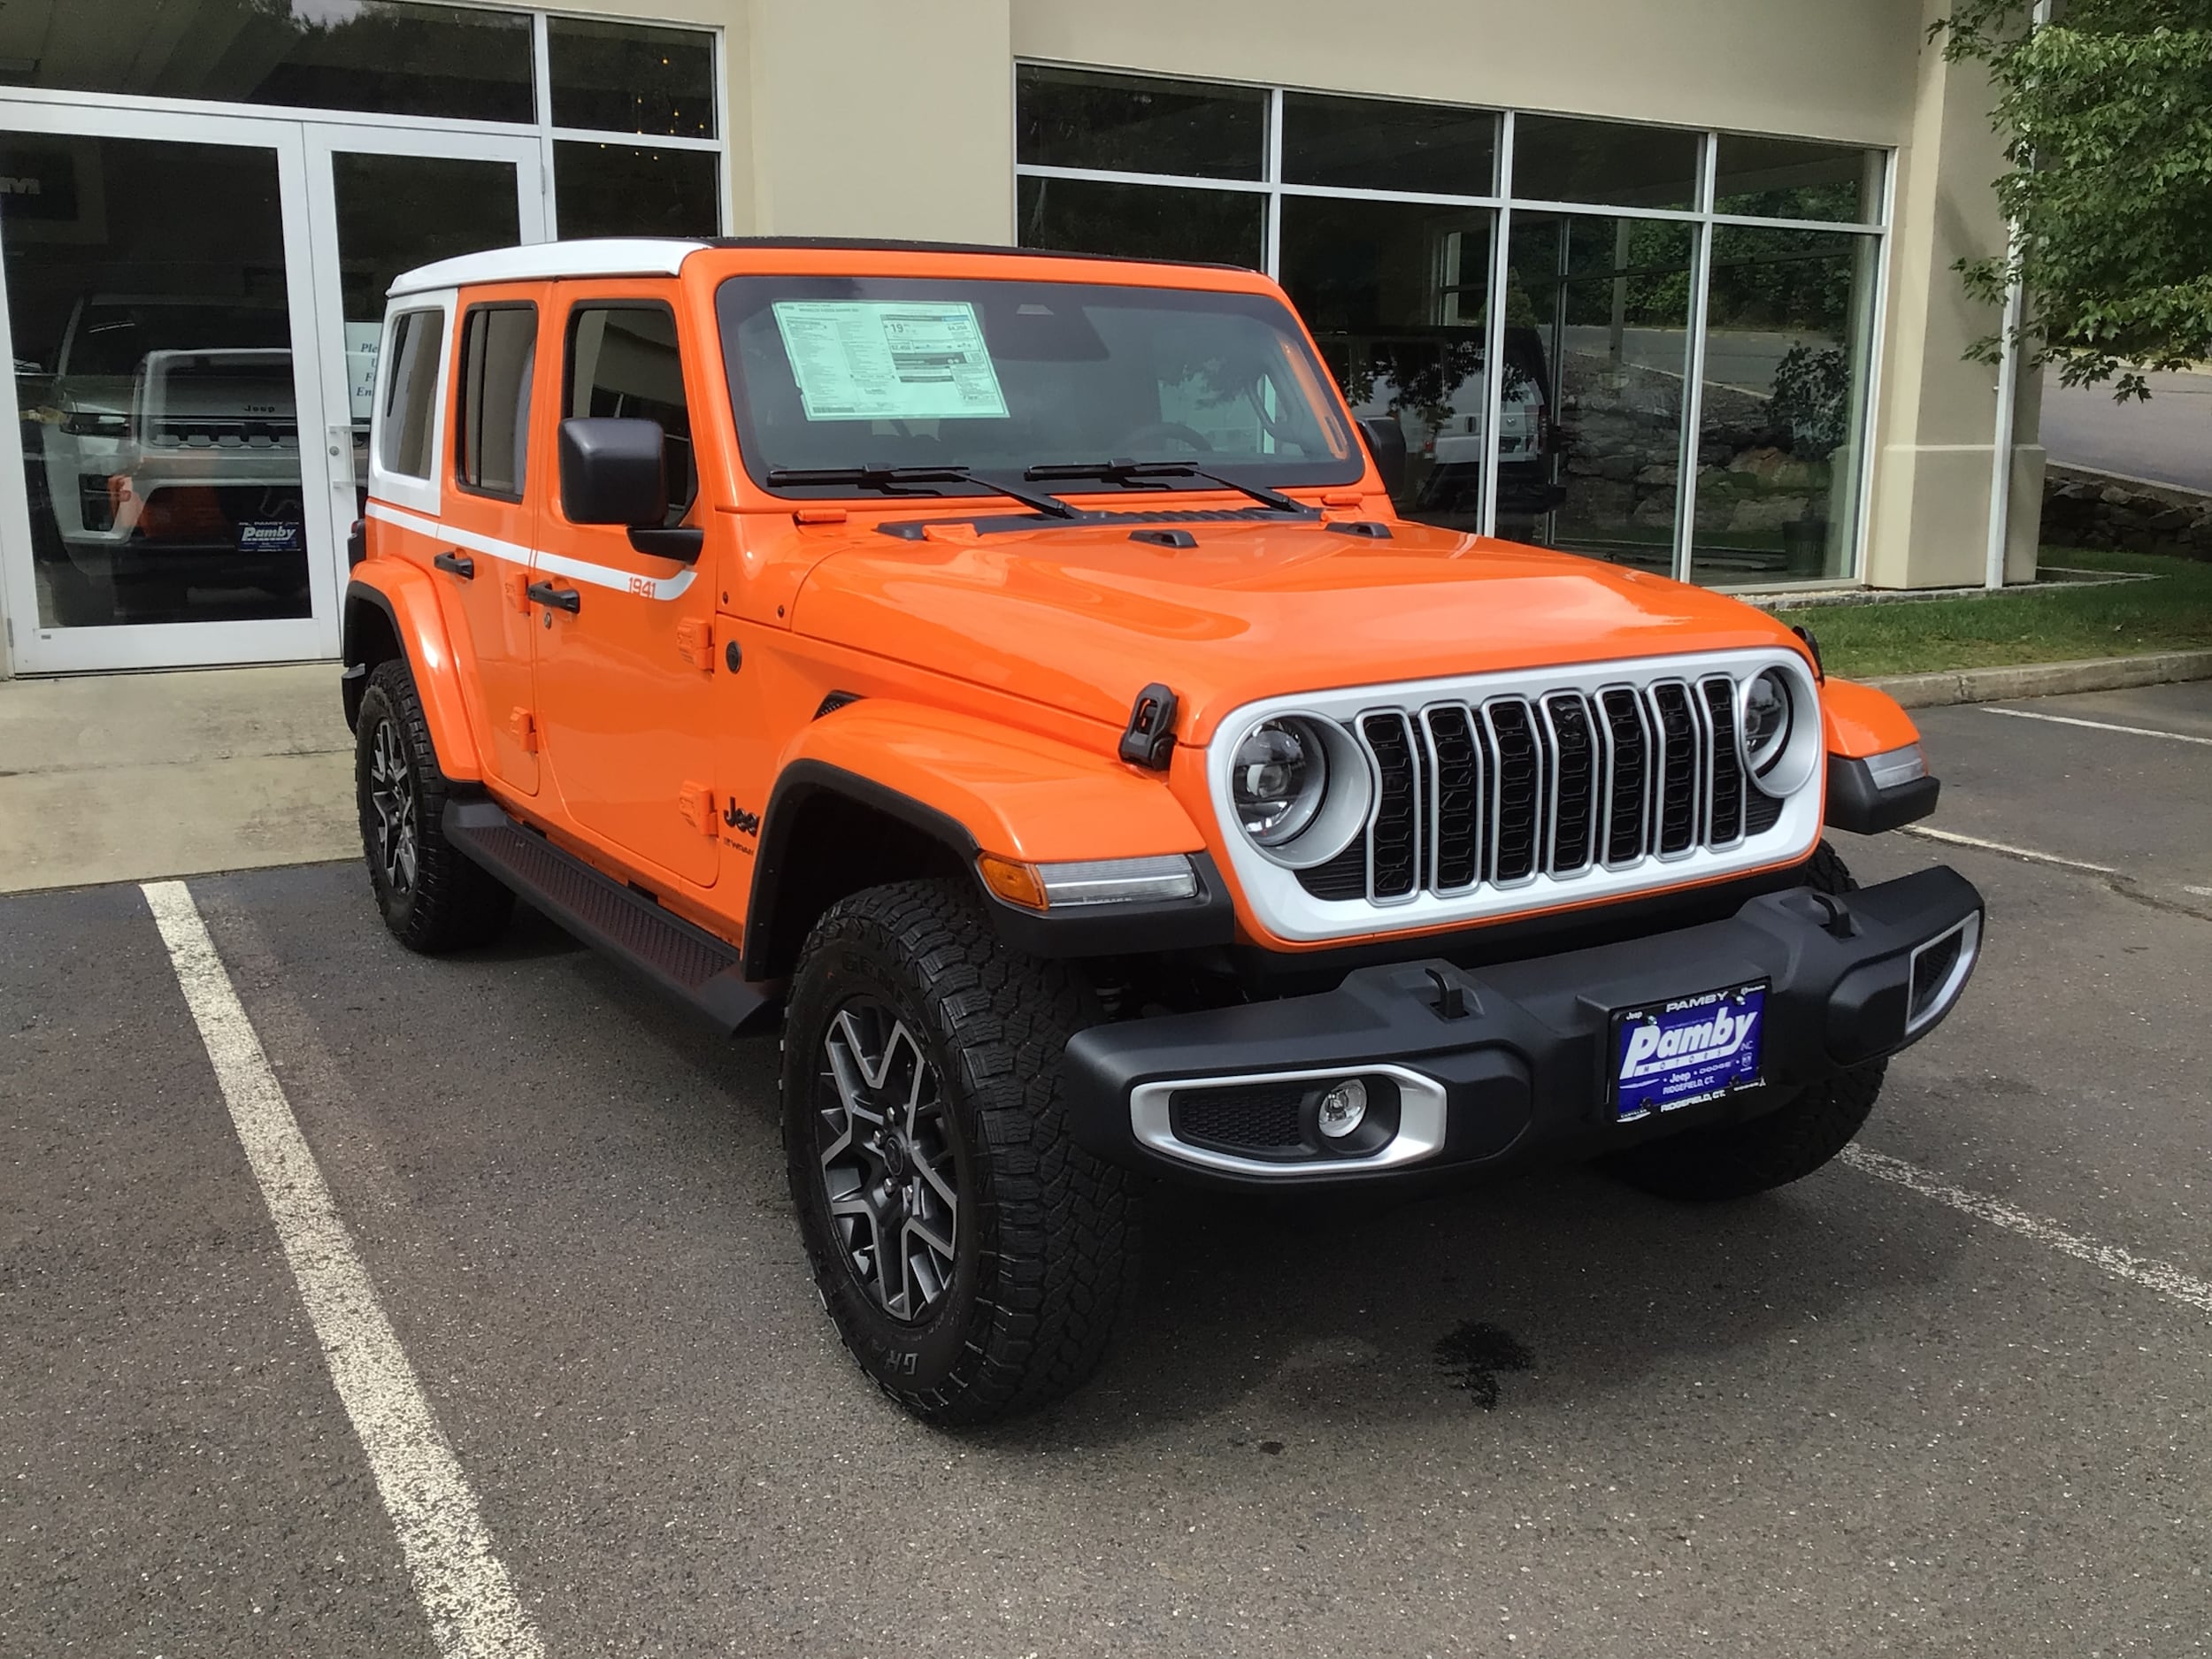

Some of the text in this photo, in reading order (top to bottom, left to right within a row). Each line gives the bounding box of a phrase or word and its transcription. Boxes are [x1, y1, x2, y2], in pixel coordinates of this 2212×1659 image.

[891, 323, 904, 334] 19
[241, 526, 296, 541] Pamby
[628, 577, 657, 599] 1941
[723, 795, 760, 838] Jee
[1666, 990, 1729, 1013] PAMBY
[1625, 1010, 1643, 1021] Jeep
[1619, 1006, 1759, 1080] Pamby
[1669, 1071, 1692, 1084] Jeep
[1699, 1062, 1732, 1075] DODGE
